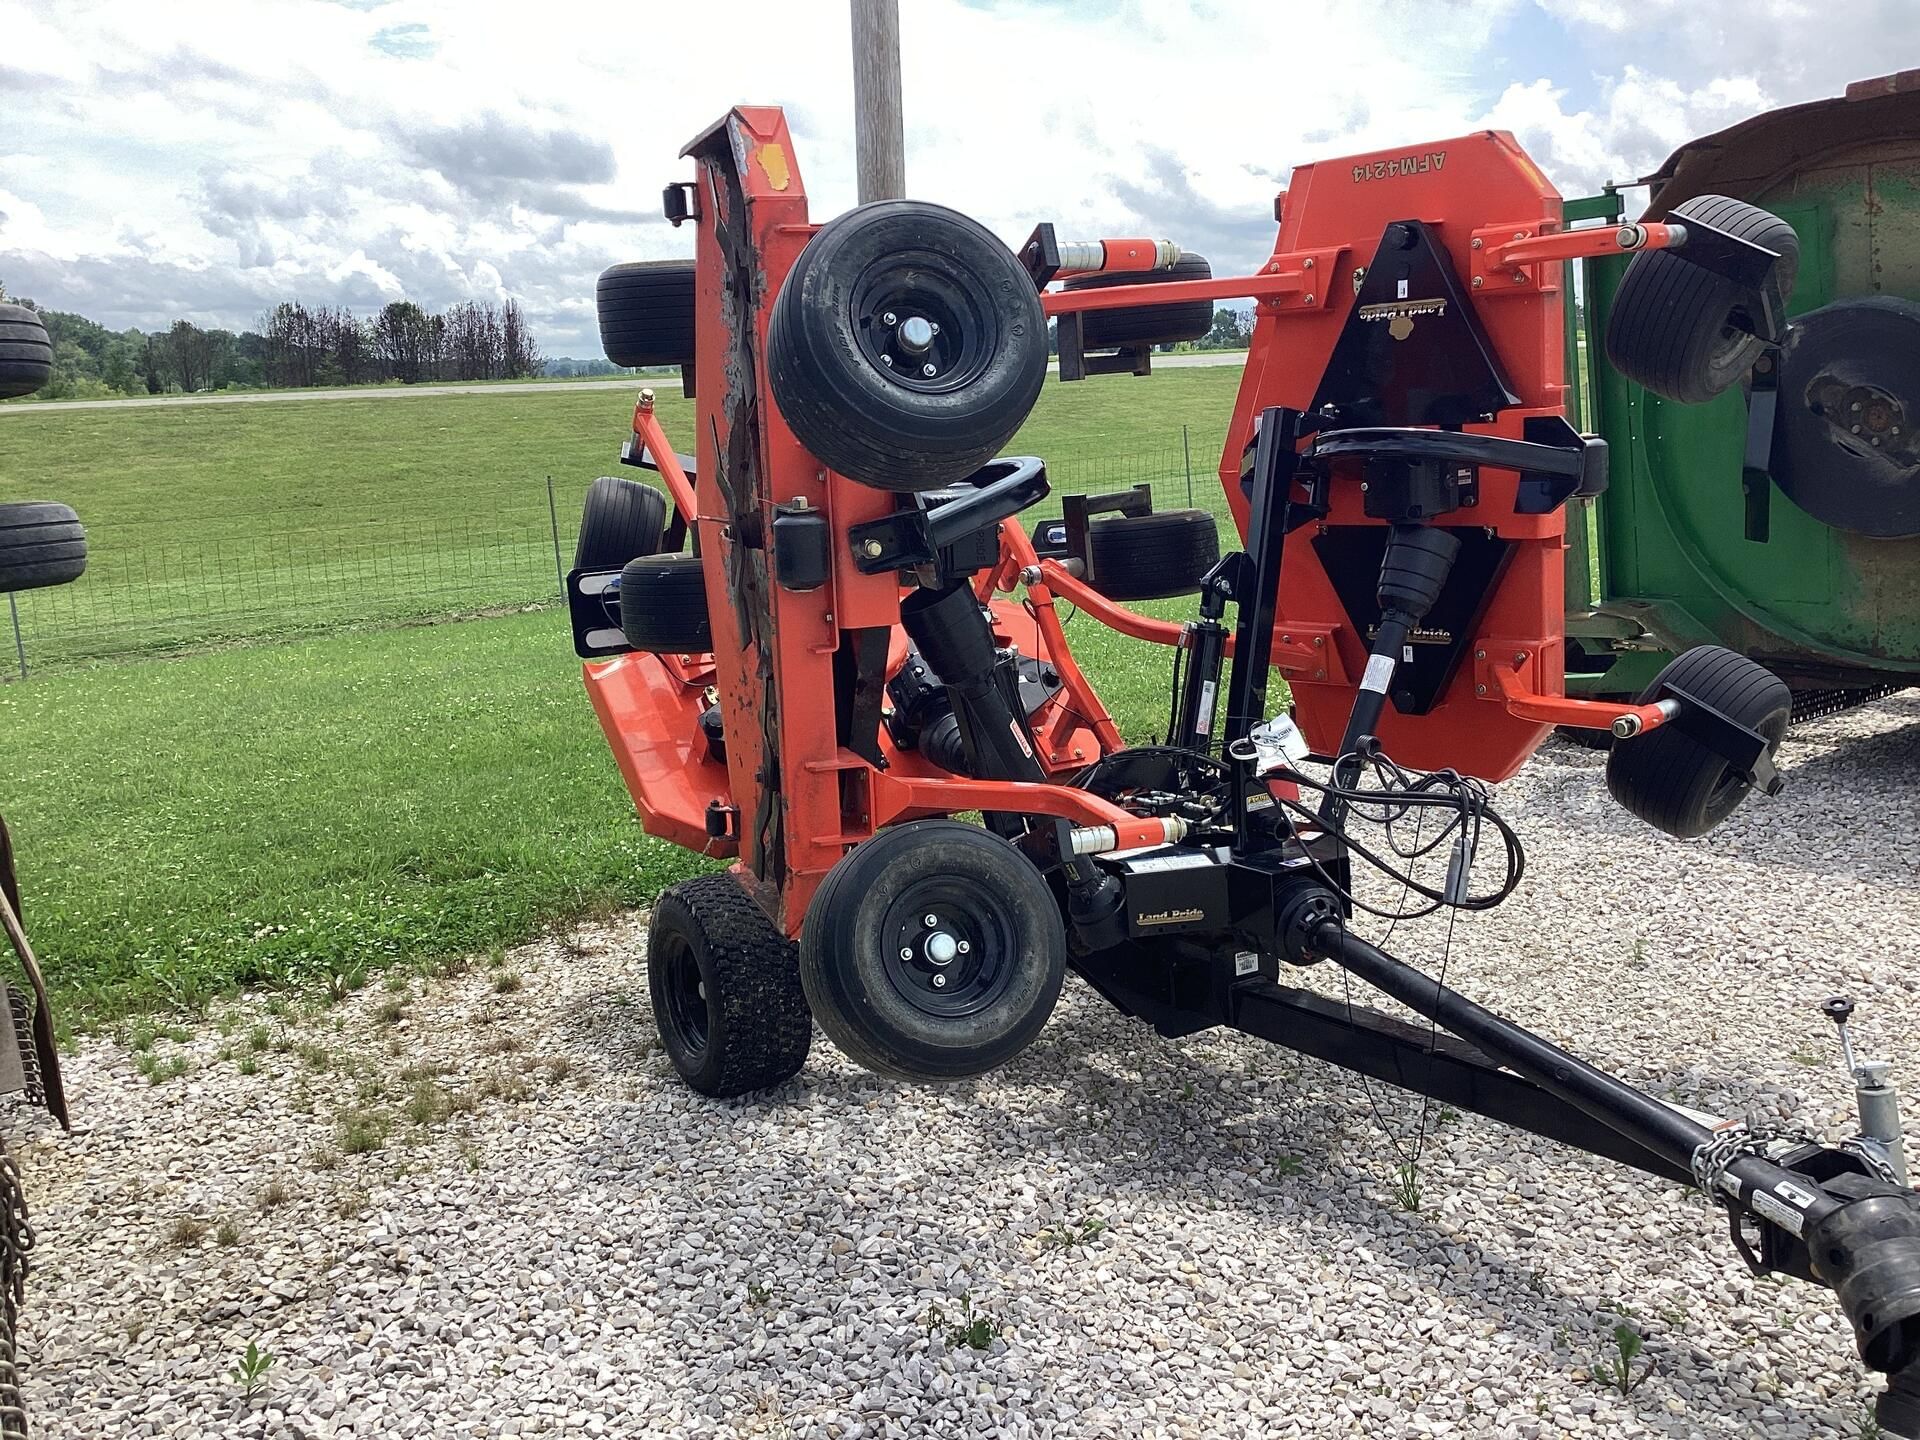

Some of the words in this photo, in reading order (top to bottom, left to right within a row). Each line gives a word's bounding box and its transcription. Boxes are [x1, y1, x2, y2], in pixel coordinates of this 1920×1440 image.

[1352, 151, 1446, 183] AFM4214
[1360, 307, 1397, 322] Pride
[1408, 302, 1447, 317] Land
[1138, 911, 1168, 923] Land
[1172, 908, 1204, 920] Pride
